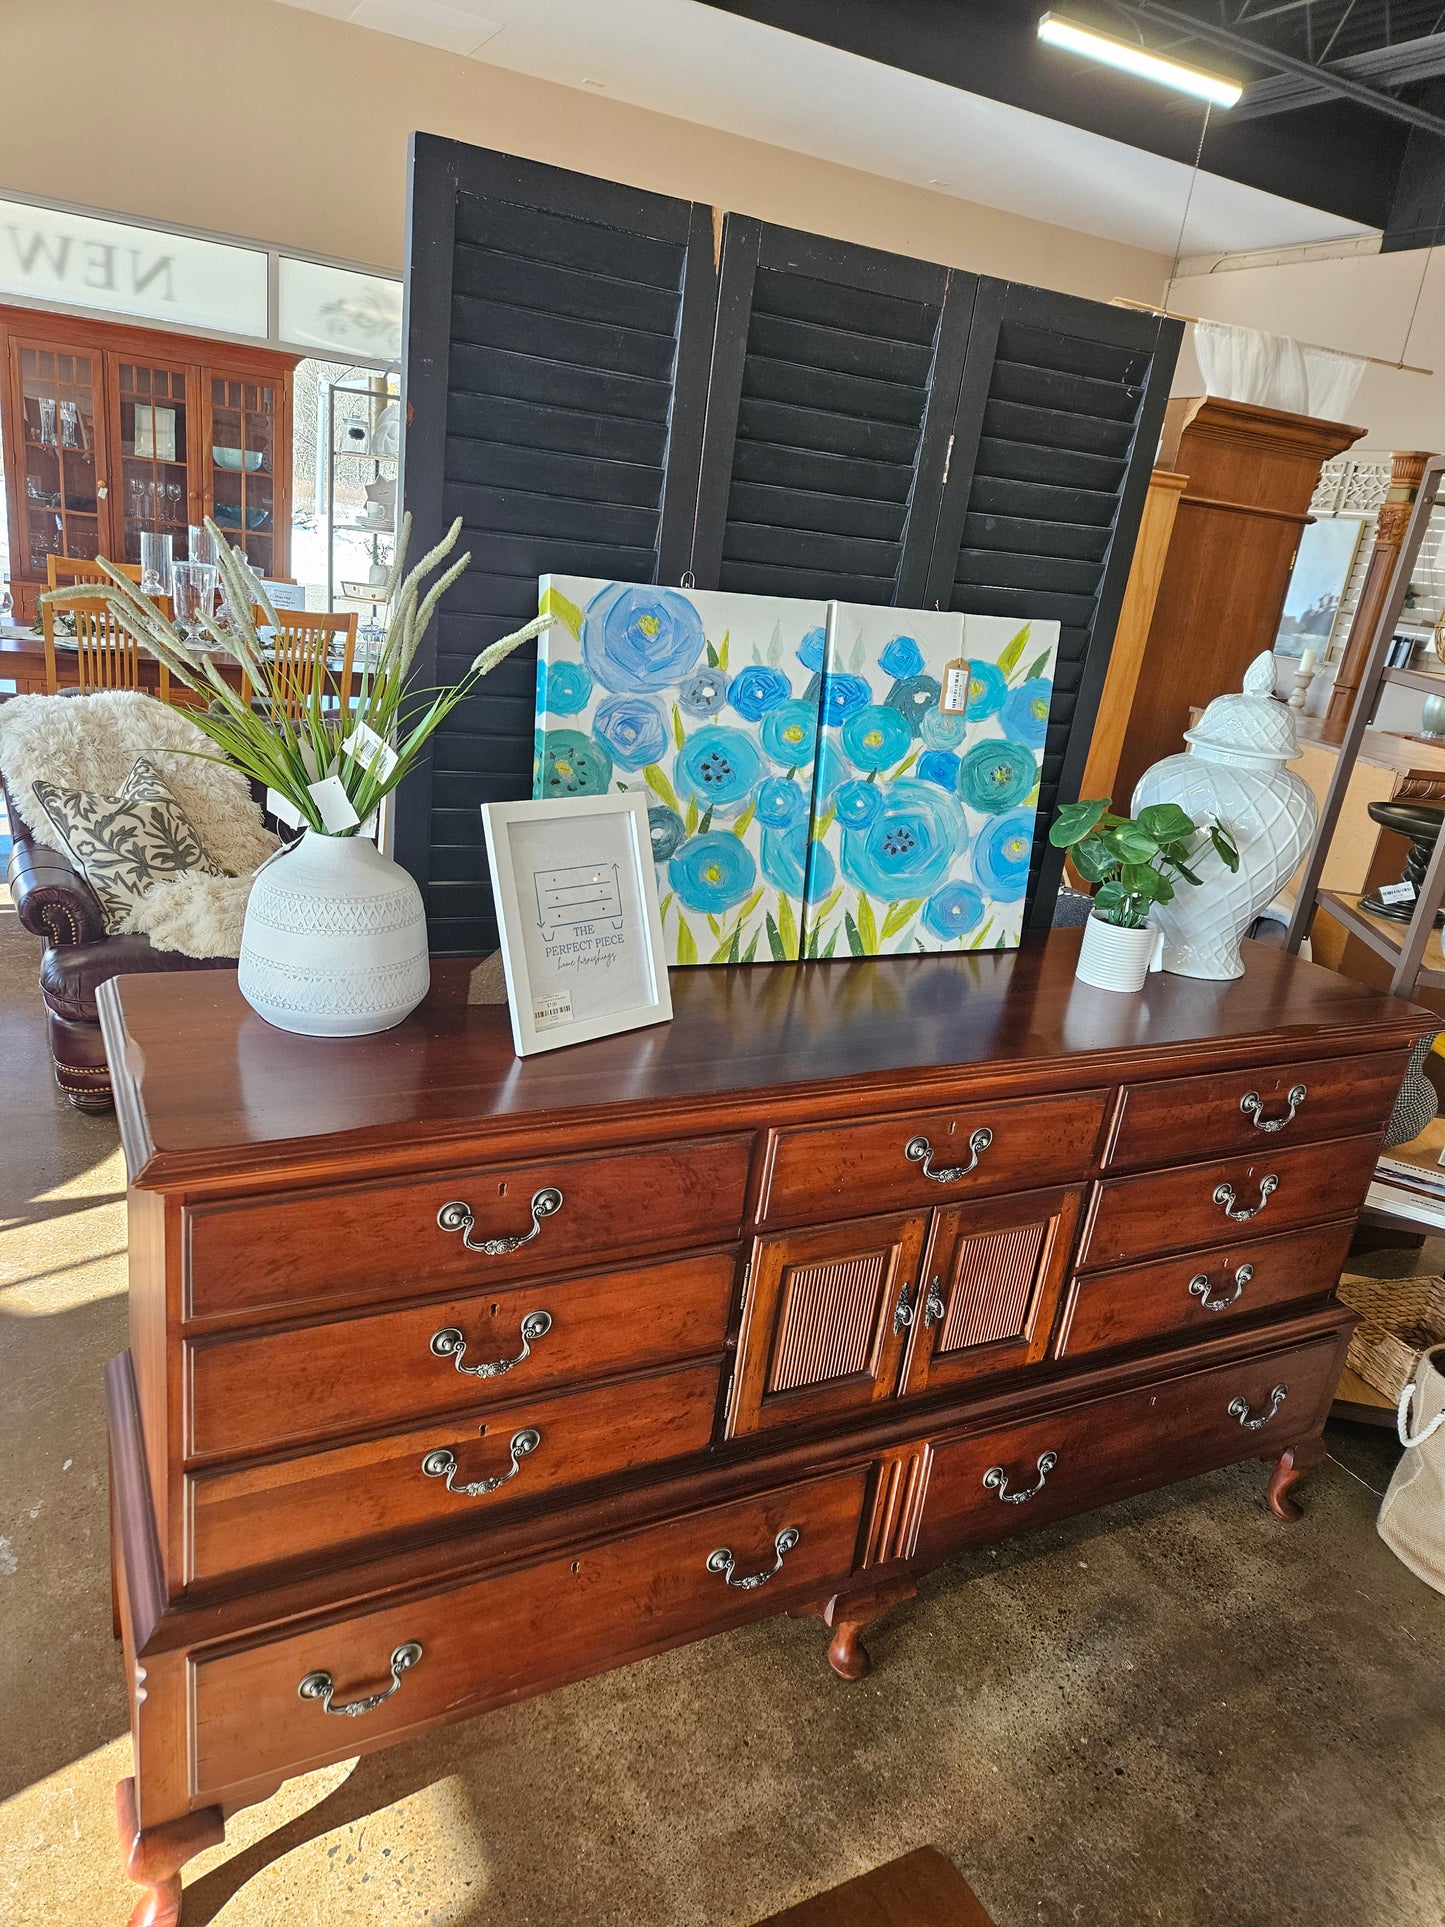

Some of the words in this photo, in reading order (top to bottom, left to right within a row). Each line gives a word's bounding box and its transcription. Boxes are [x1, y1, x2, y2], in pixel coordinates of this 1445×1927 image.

[573, 925, 595, 937] THE
[545, 939, 592, 957] PERFECT
[595, 934, 624, 948] PIECE
[558, 957, 575, 970] home
[577, 949, 617, 972] furnishings
